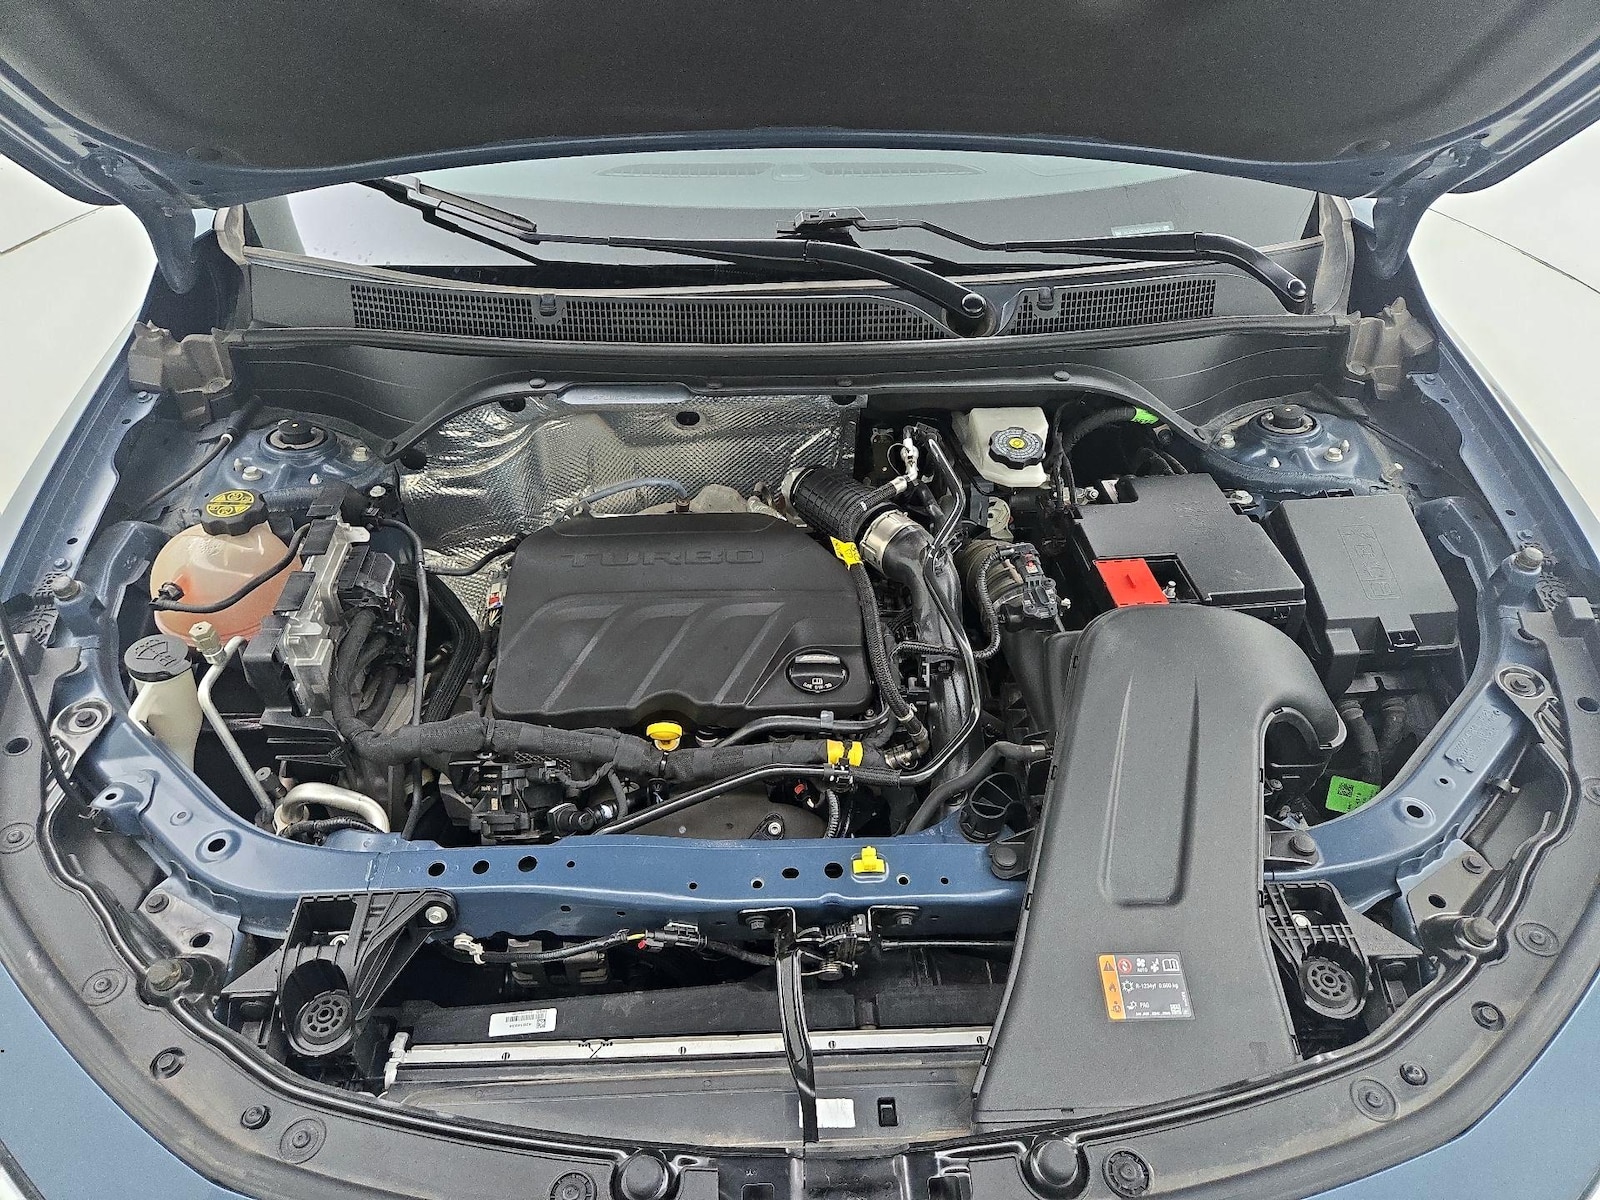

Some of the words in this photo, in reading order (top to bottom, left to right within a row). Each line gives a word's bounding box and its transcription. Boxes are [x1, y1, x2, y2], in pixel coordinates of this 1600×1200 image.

[560, 549, 764, 567] TURBO
[1135, 982, 1156, 991] R-1234yf
[1172, 982, 1179, 990] kg
